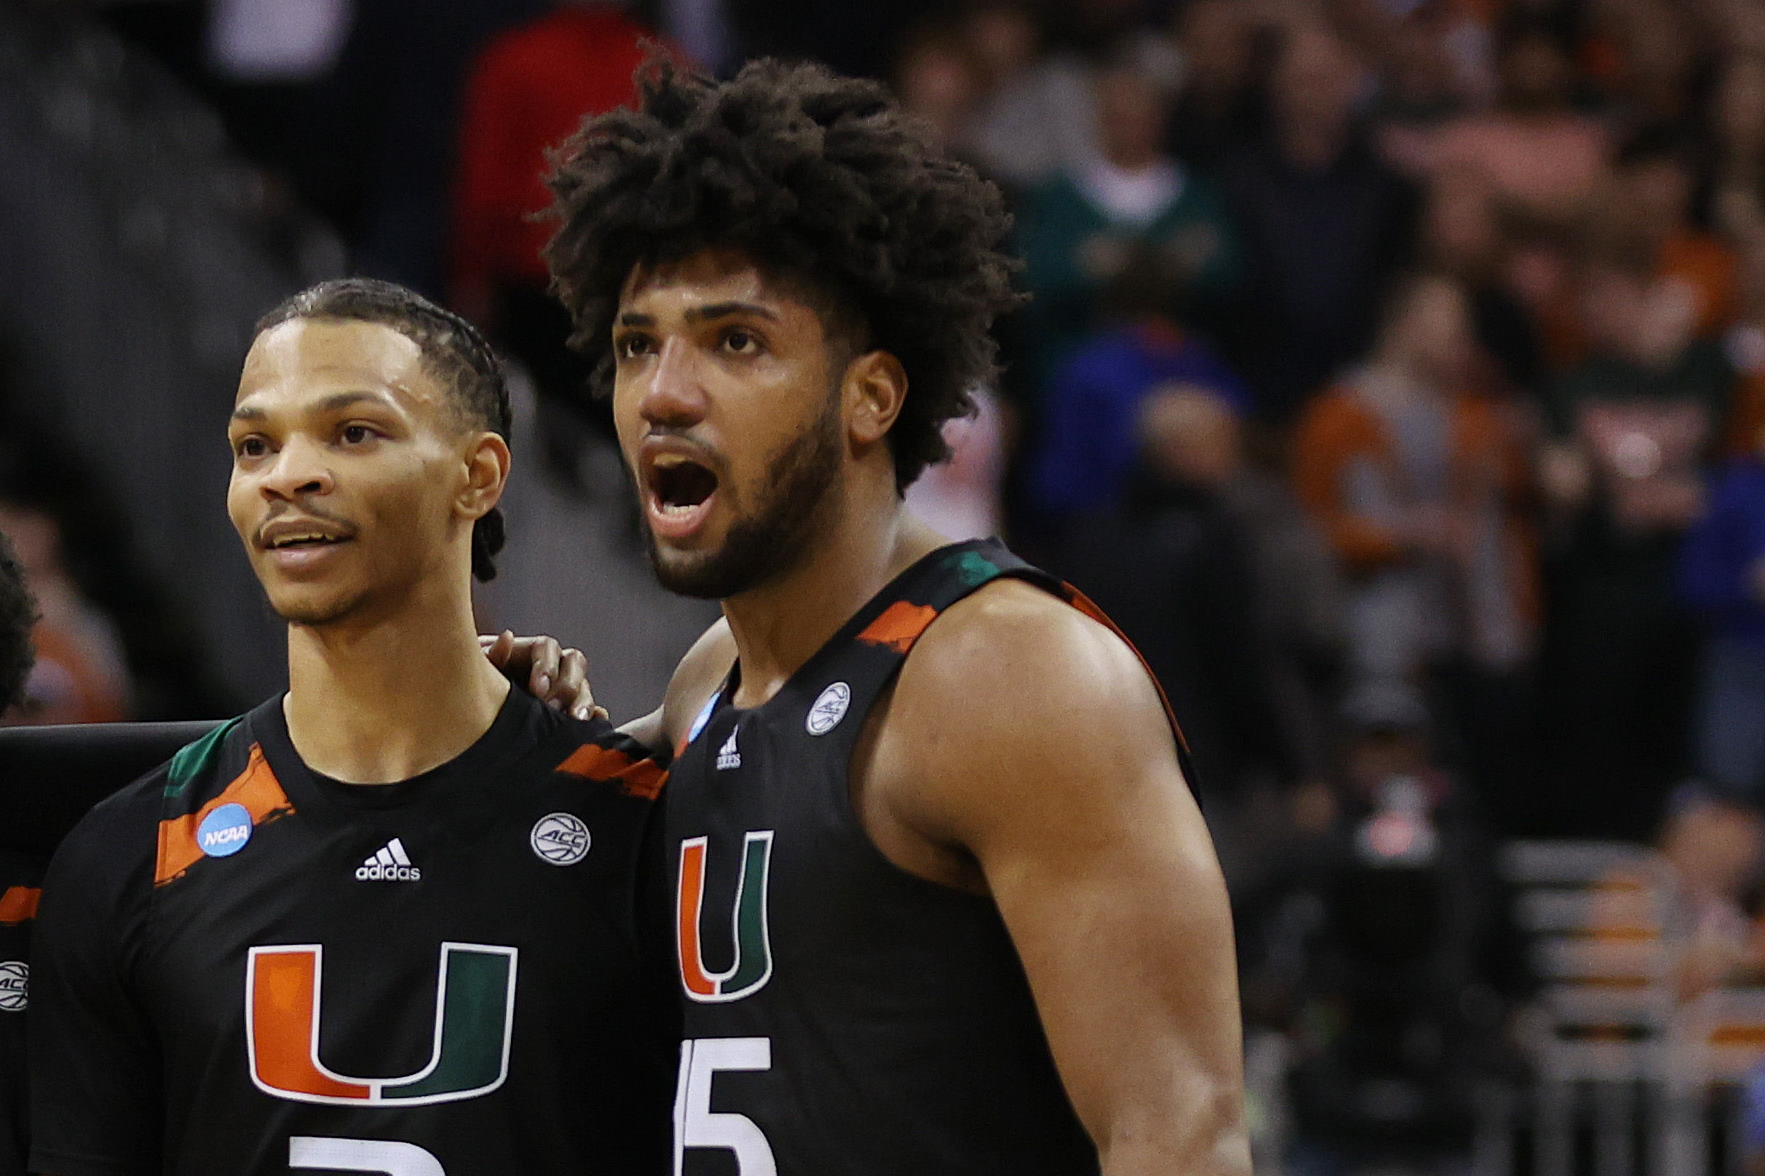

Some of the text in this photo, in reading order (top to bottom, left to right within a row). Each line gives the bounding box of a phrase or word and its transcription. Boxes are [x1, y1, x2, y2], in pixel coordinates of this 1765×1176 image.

[204, 824, 248, 846] NCAA
[540, 829, 585, 847] ACC
[355, 863, 421, 881] adidas
[676, 830, 775, 1002] U
[245, 942, 519, 1108] U
